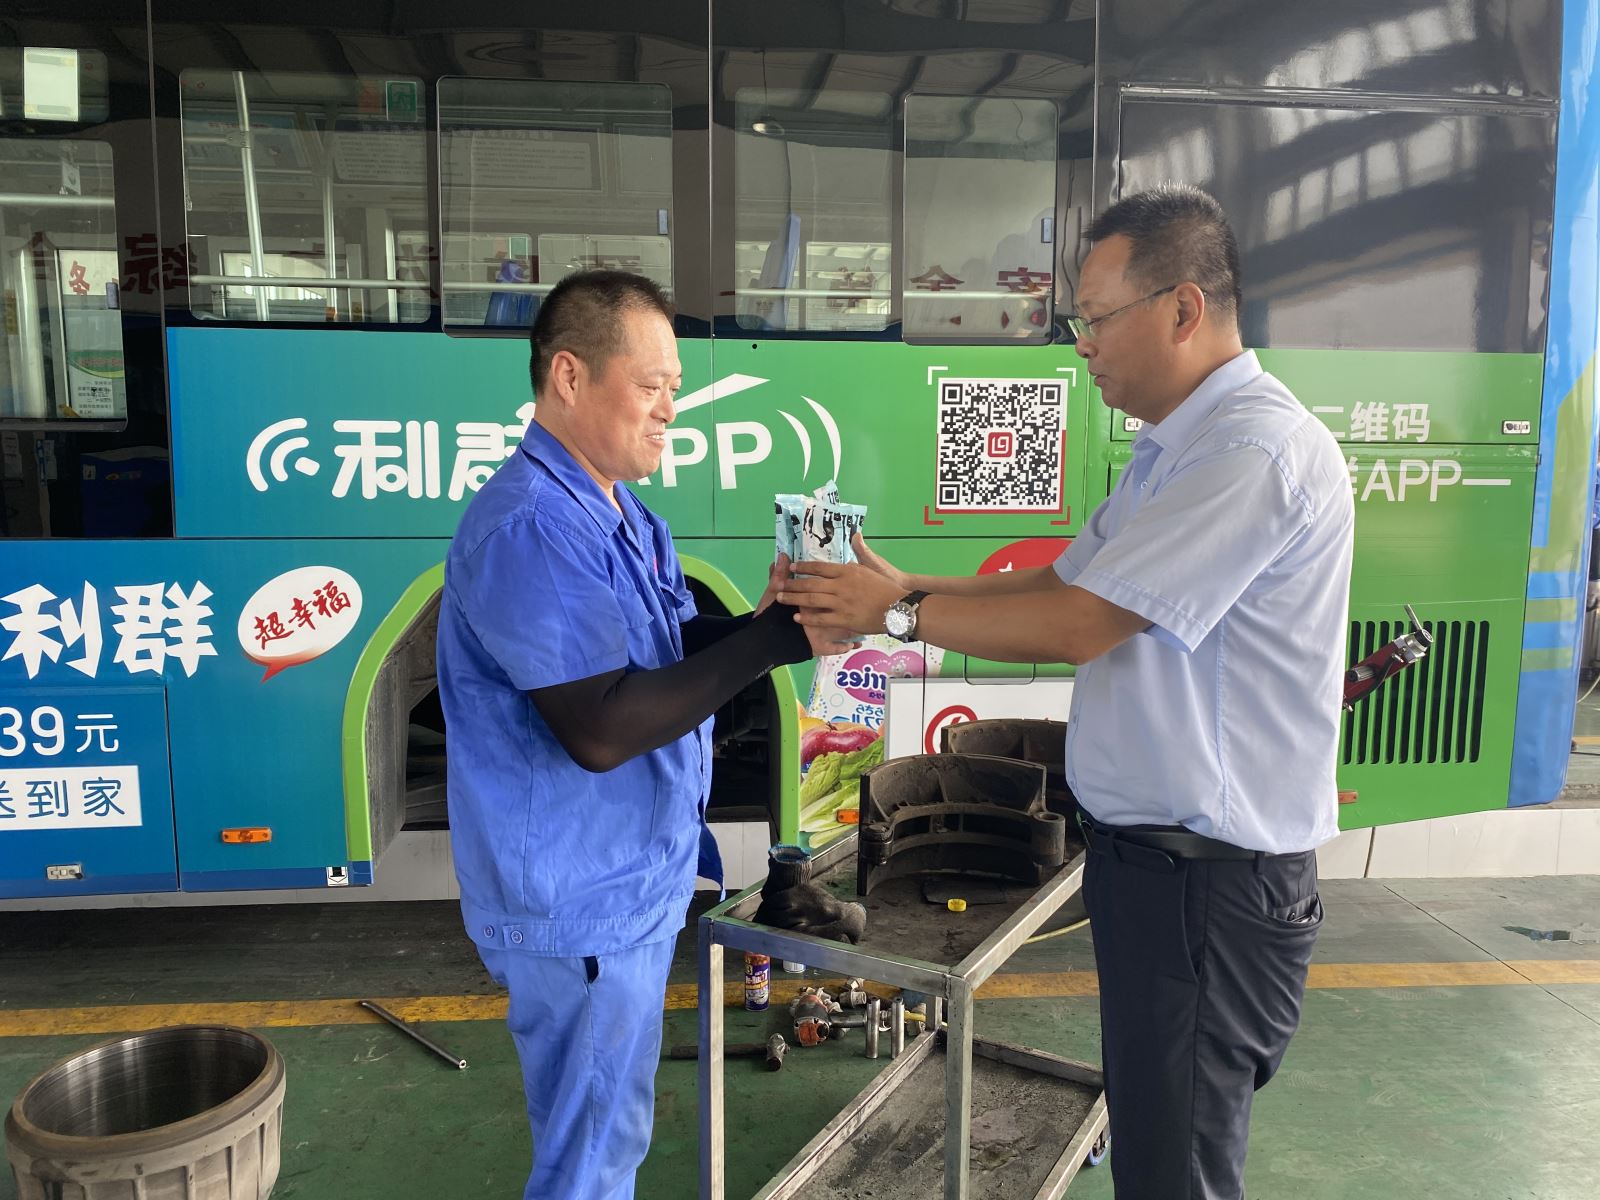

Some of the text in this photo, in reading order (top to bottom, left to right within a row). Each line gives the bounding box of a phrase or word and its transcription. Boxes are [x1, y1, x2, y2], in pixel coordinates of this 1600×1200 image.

[0, 580, 218, 680] 利群
[254, 580, 351, 650] 超幸福
